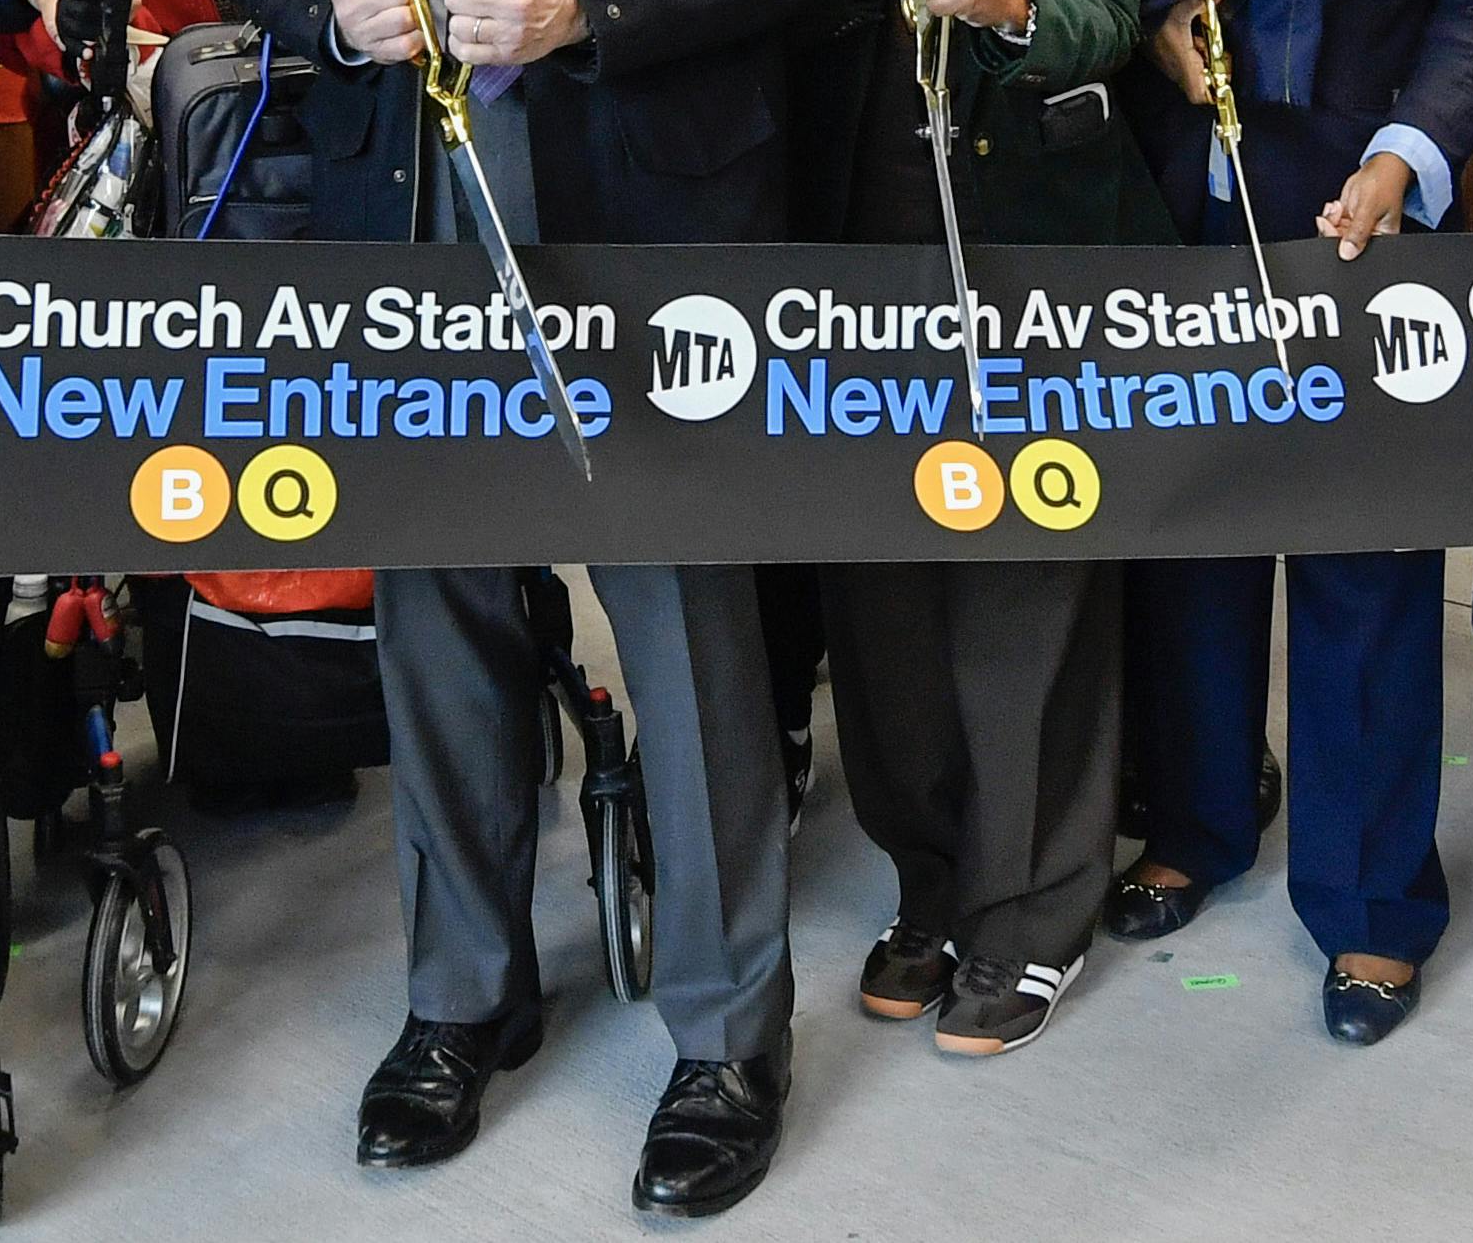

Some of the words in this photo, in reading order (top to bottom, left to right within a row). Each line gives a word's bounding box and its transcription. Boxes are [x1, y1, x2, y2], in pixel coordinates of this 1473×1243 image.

[256, 286, 351, 349] Av
[765, 288, 1001, 350] Church
[1013, 289, 1093, 349] Av
[1104, 287, 1340, 349] Station
[1372, 311, 1449, 376] MTA
[647, 326, 737, 393] MTA
[204, 357, 612, 439] Entrance
[766, 358, 954, 436] New
[973, 358, 1345, 433] Entrance
[161, 469, 204, 521] B
[264, 469, 314, 518] Q
[941, 462, 983, 510] B
[1034, 461, 1081, 508] Q
